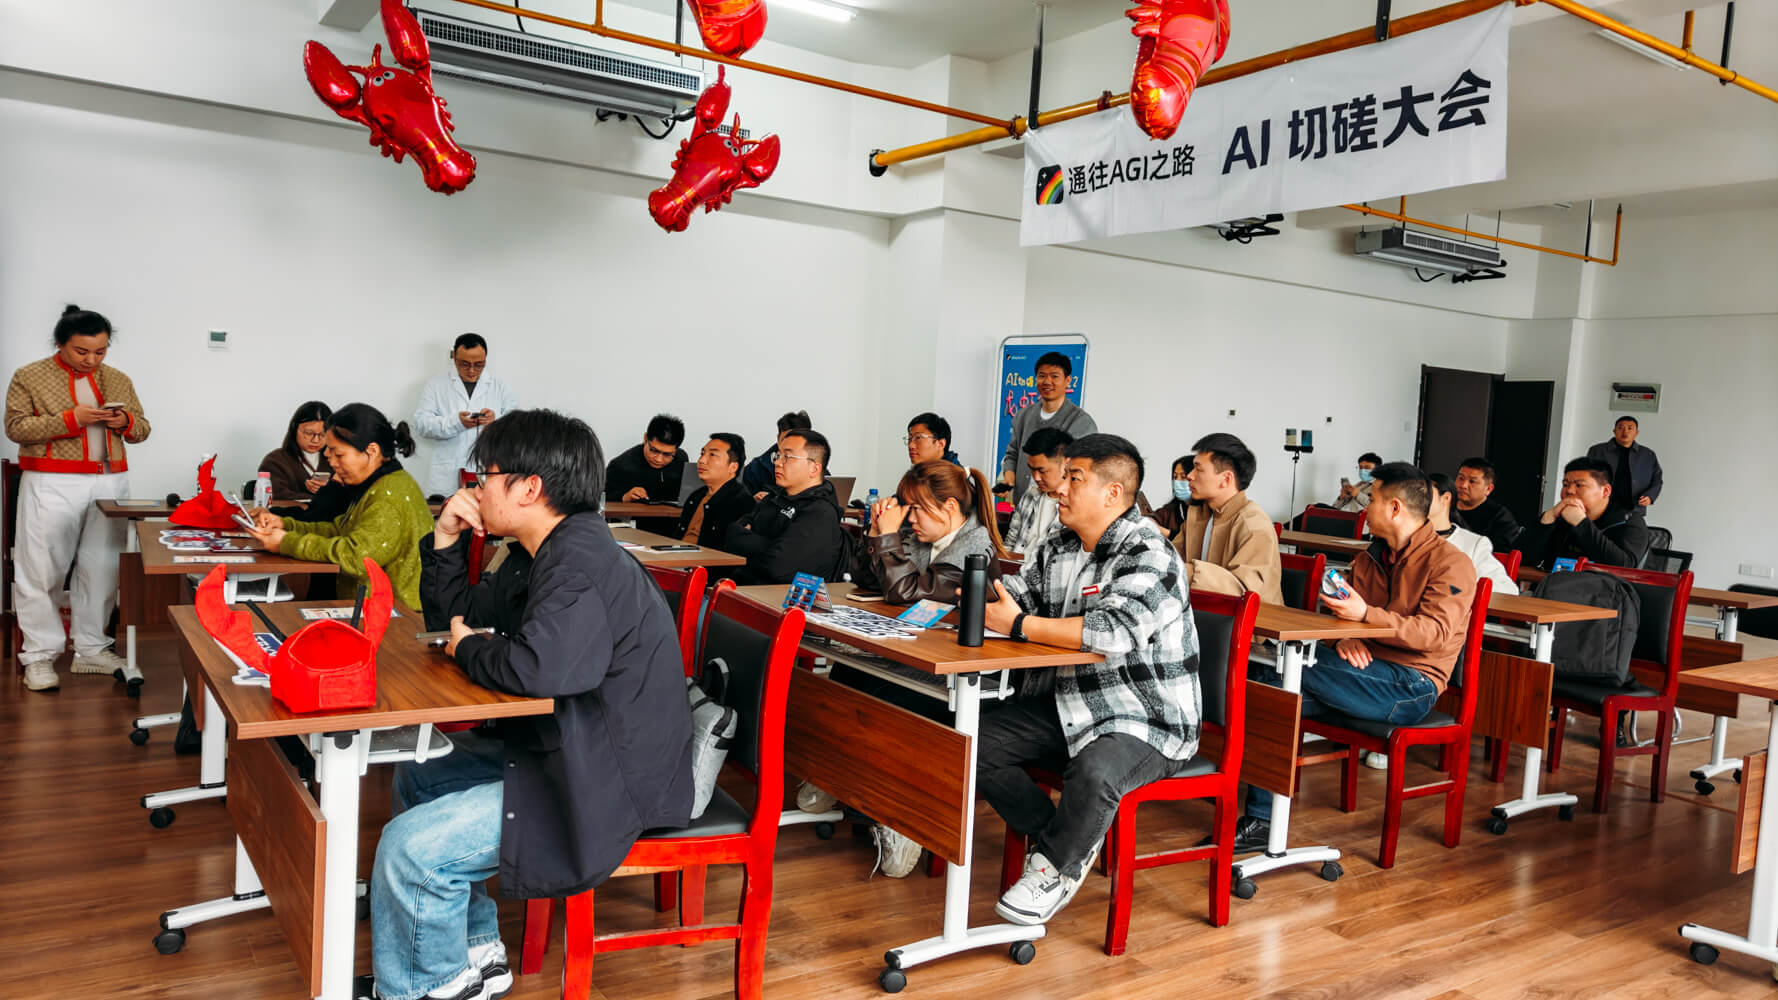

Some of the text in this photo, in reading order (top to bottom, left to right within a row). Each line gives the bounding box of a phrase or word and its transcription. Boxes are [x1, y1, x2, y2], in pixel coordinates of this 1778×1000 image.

[1221, 68, 1491, 175] AI 切磋大会
[1068, 144, 1196, 196] 通往AGI之路
